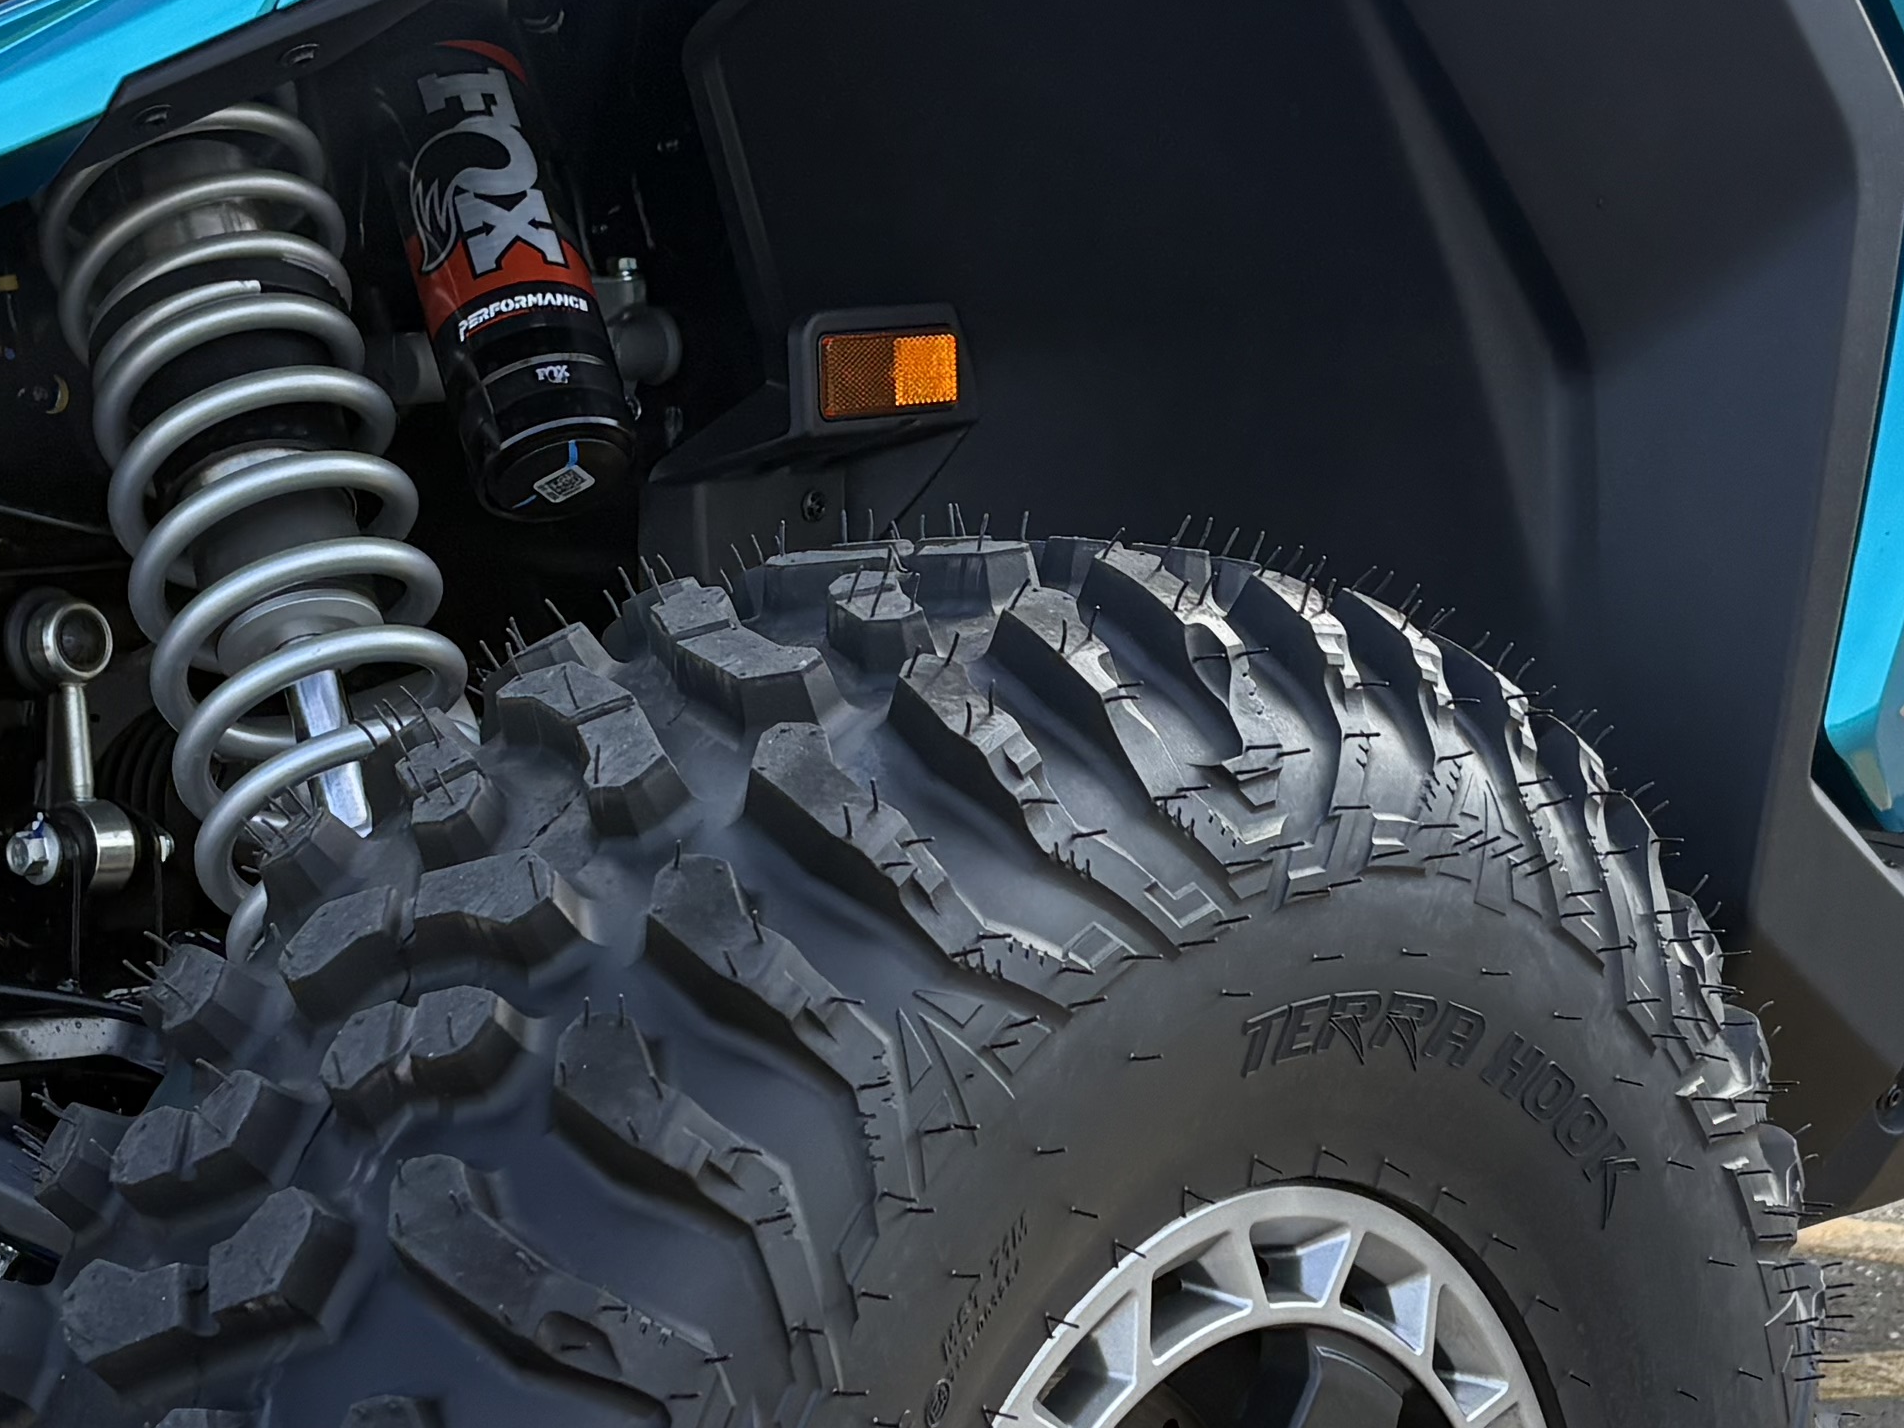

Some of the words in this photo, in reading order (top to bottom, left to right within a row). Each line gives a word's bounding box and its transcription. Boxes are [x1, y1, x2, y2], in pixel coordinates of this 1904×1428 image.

[410, 66, 570, 276] FOX
[458, 291, 589, 343] PERFORMANCE
[535, 363, 570, 384] FOX
[1240, 988, 1487, 1078] TERRA
[1479, 1029, 1641, 1231] HOOK
